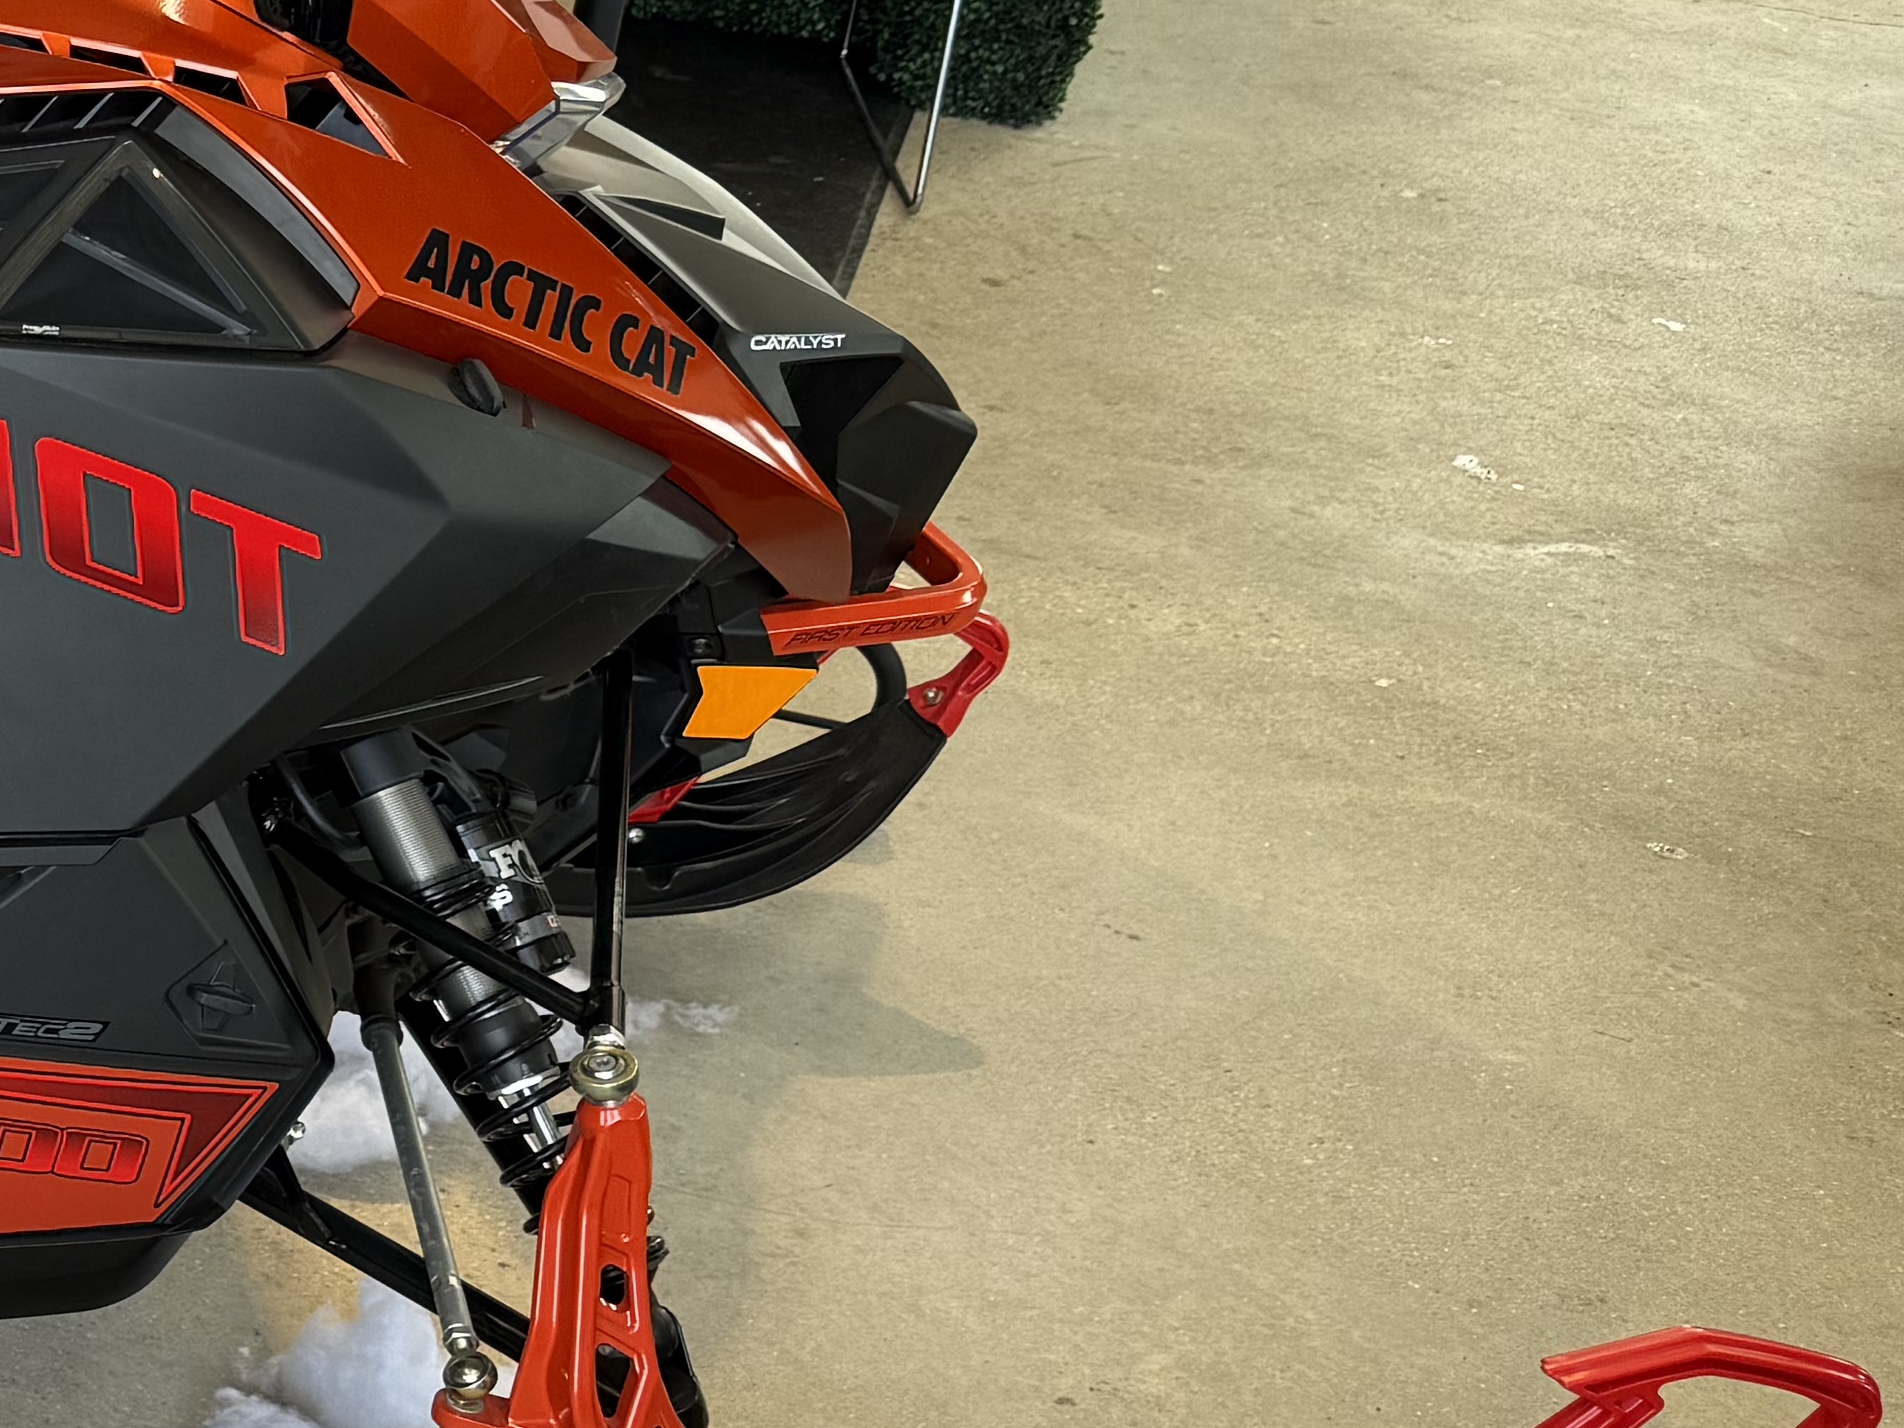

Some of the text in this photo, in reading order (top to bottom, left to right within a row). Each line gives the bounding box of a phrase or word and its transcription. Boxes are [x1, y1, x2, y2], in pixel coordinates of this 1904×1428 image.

[404, 227, 696, 395] ARCTIC CAT
[750, 333, 846, 351] CATALYST
[786, 614, 956, 648] FIRST EDITION
